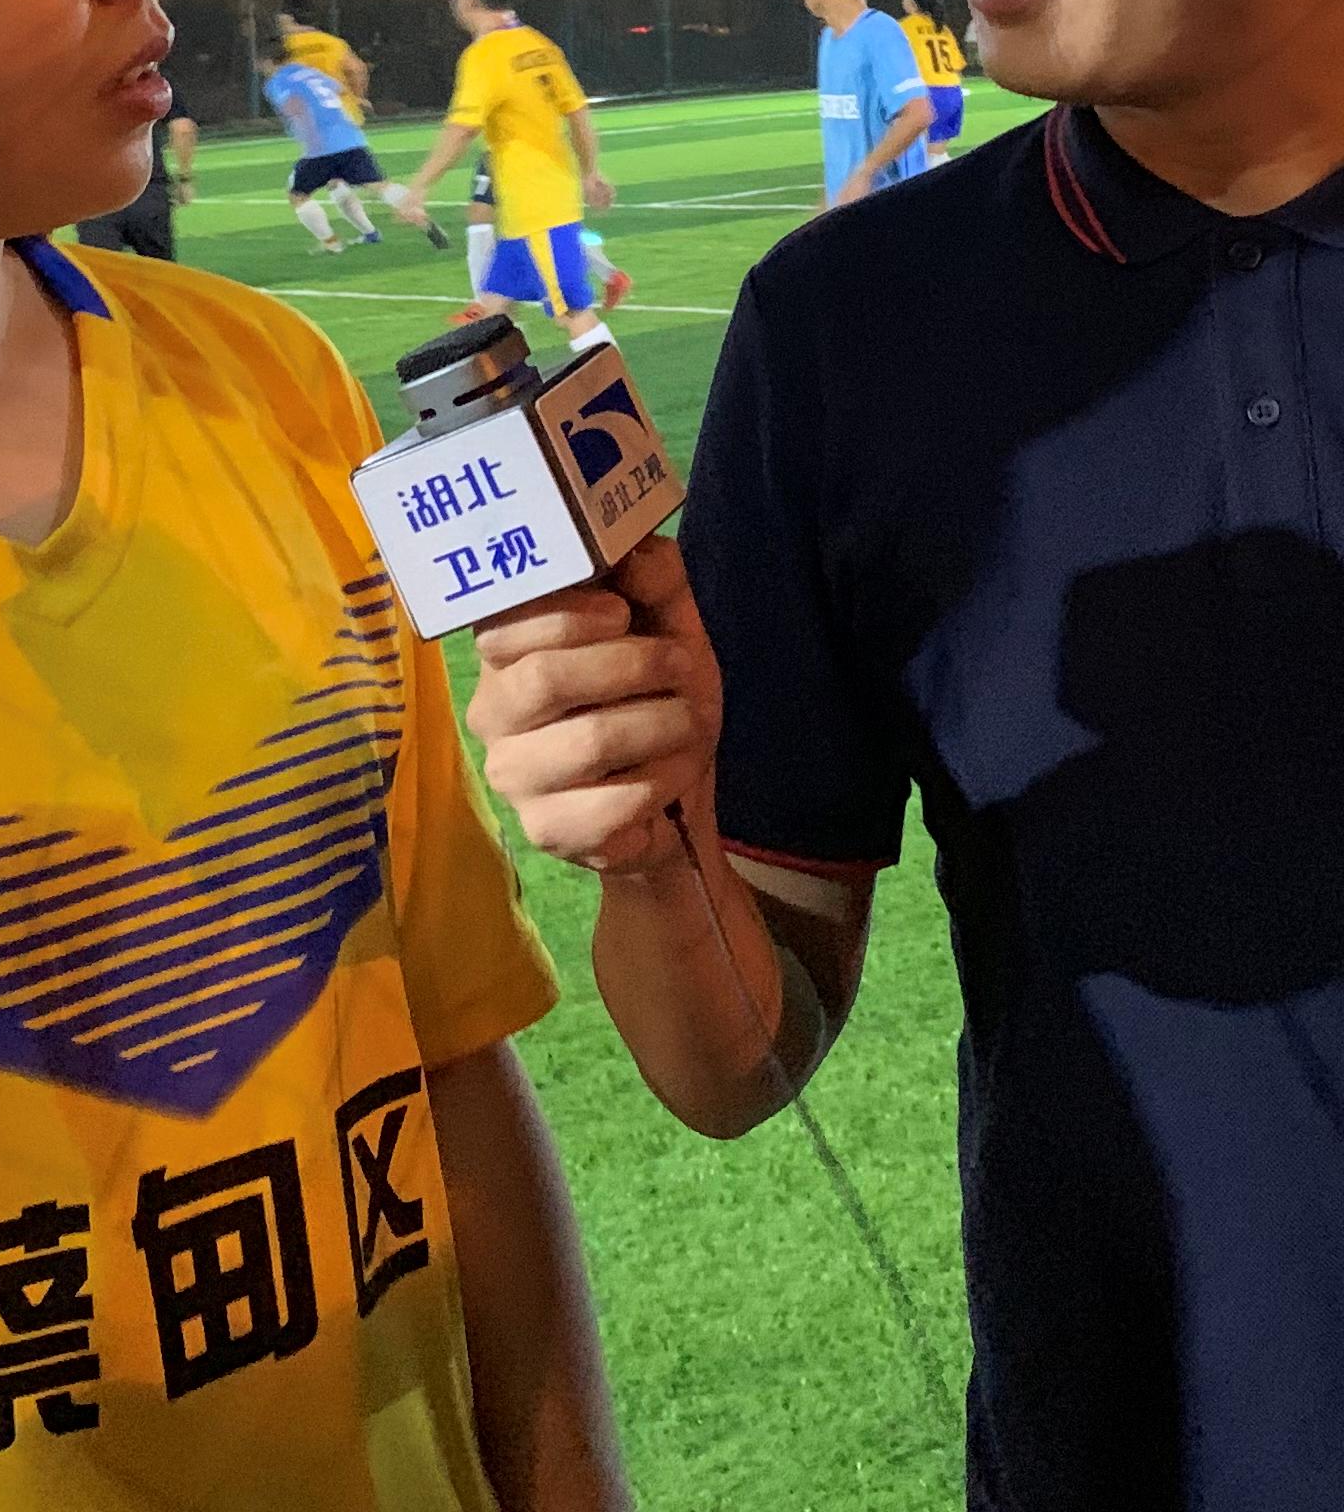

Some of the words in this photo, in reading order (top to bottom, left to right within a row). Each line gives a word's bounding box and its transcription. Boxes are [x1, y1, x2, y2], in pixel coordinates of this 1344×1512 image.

[924, 38, 955, 74] 15
[396, 455, 517, 534] 湖北
[432, 524, 548, 603] 卫视
